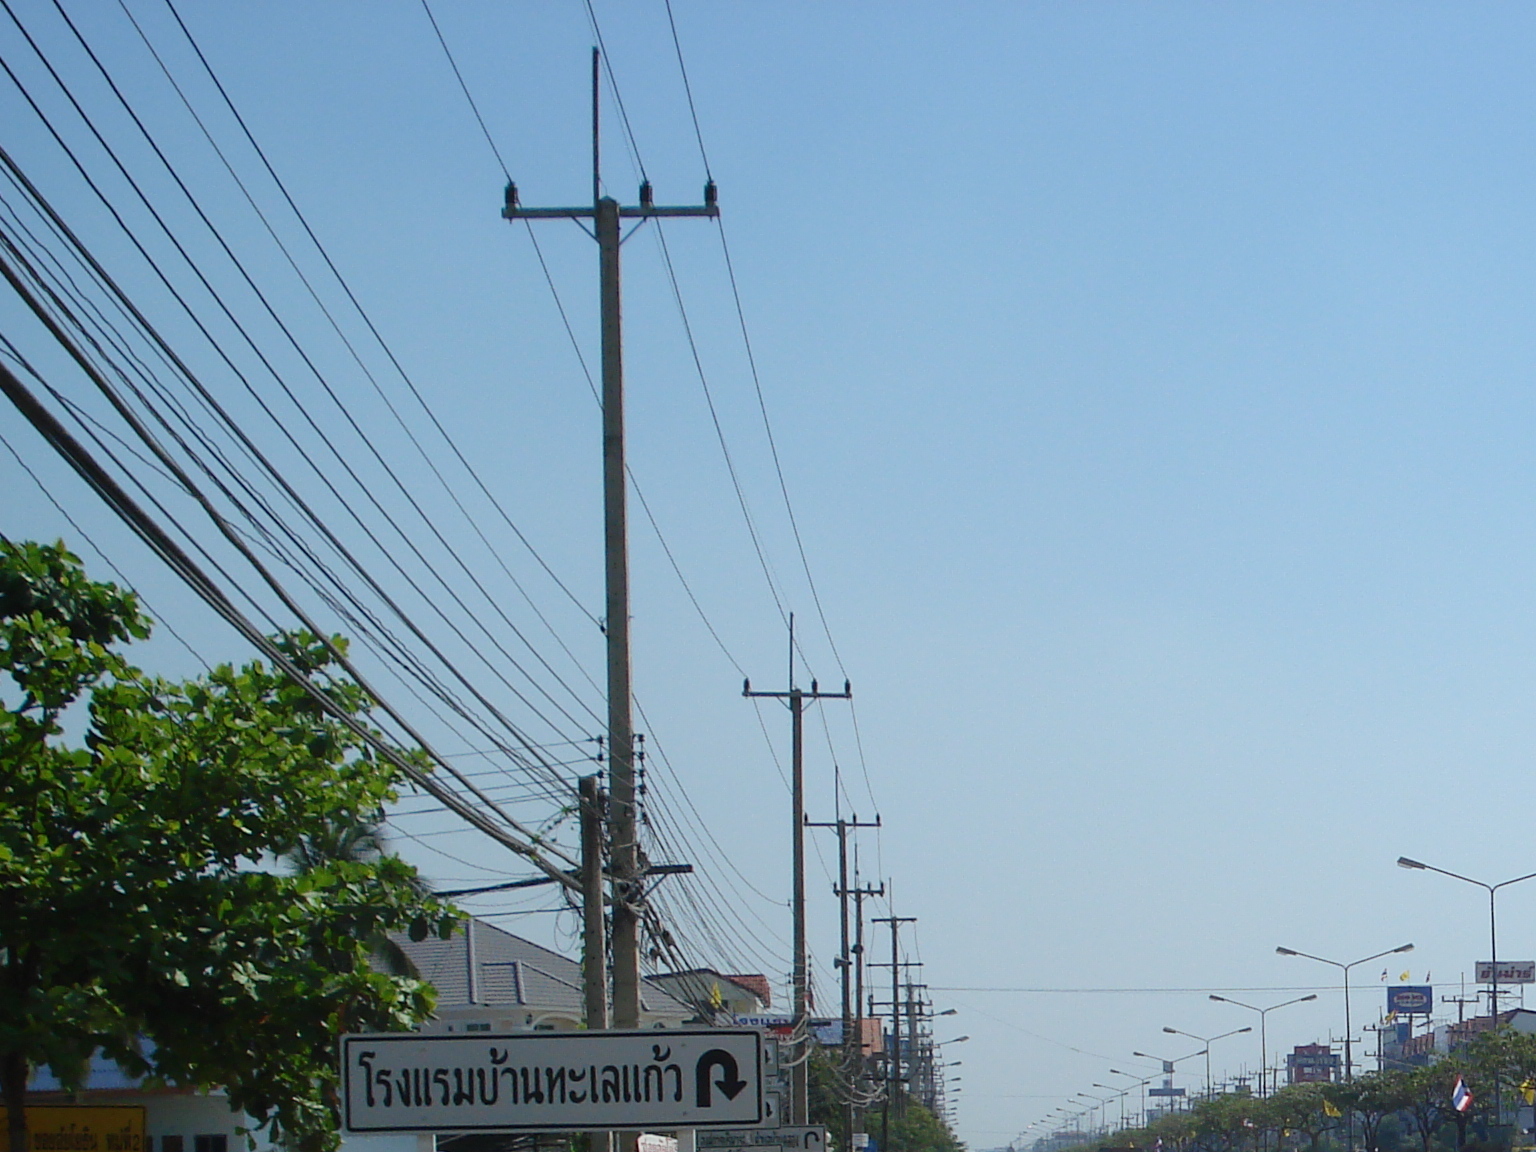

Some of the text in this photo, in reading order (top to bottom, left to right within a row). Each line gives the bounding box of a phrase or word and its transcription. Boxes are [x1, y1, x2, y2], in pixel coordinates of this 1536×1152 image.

[358, 1044, 683, 1107] โรงแรมบ้านทะเลแก้ว
